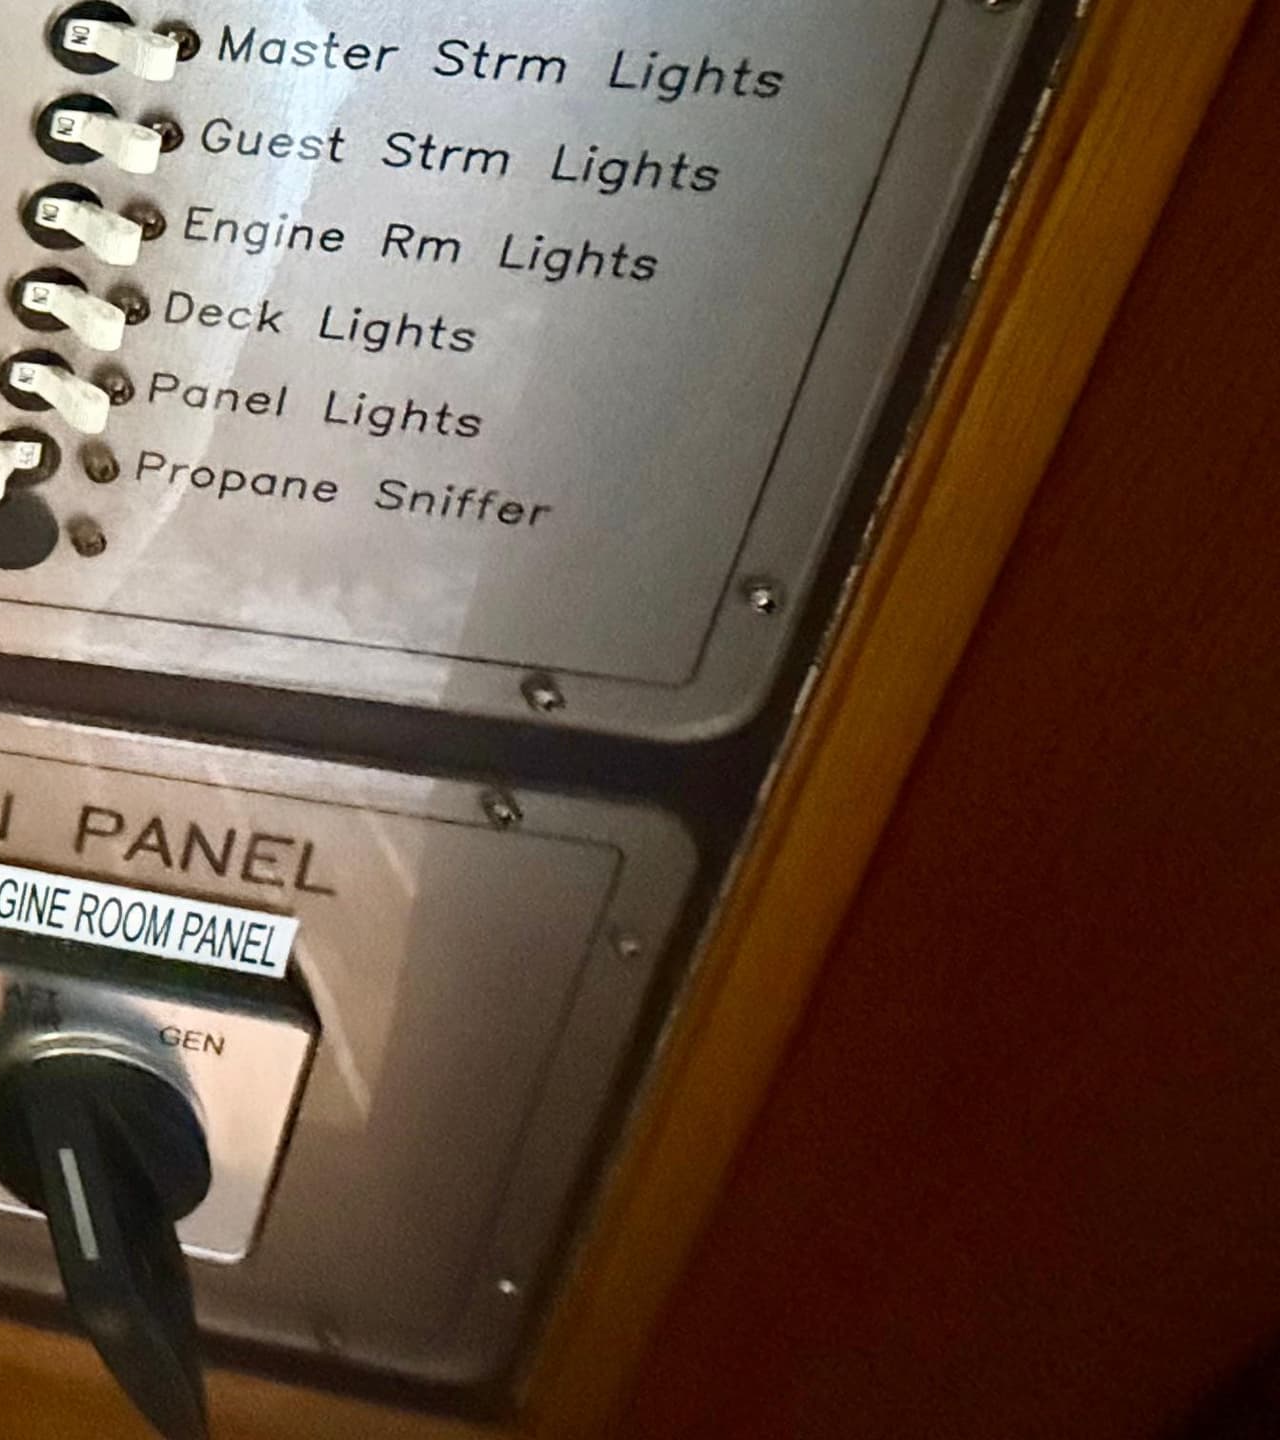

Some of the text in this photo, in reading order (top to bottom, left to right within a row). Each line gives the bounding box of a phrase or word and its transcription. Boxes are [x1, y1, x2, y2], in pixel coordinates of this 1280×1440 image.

[70, 24, 92, 47] ON
[218, 25, 784, 103] Master Strm Lights
[57, 115, 78, 137] ON
[201, 118, 719, 195] Guest Strm Lights
[41, 203, 62, 224] ON
[184, 206, 657, 283] Engine Rm Lights
[165, 290, 476, 353] Deck Lights
[148, 372, 482, 437] Panel Lights
[136, 450, 550, 525] Propane Sniffer
[76, 803, 340, 898] PANEL
[75, 893, 175, 948] ROOM
[179, 912, 277, 968] PANEL
[159, 1025, 225, 1056] GEN
